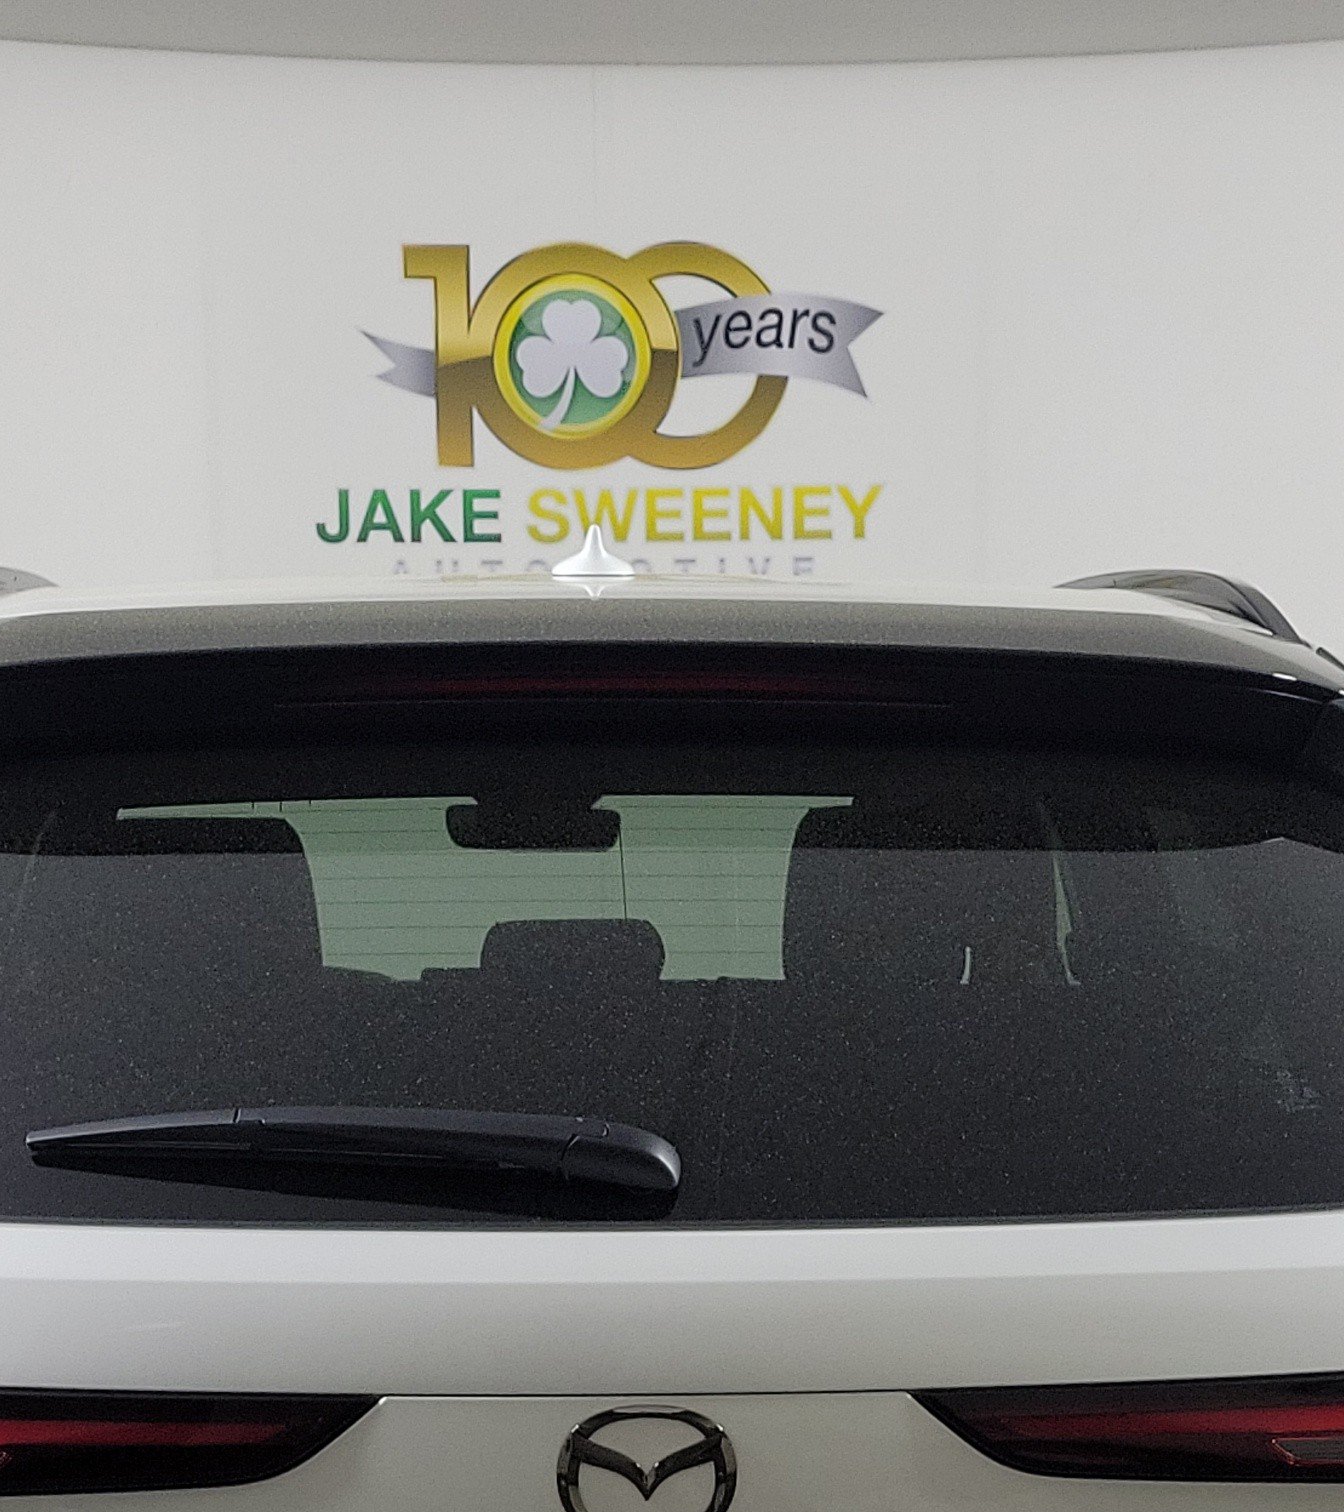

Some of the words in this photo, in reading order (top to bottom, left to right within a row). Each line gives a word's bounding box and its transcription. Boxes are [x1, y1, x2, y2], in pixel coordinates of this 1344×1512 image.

[692, 306, 837, 367] years
[316, 488, 502, 543] JAKE
[526, 484, 884, 544] SWEENEY
